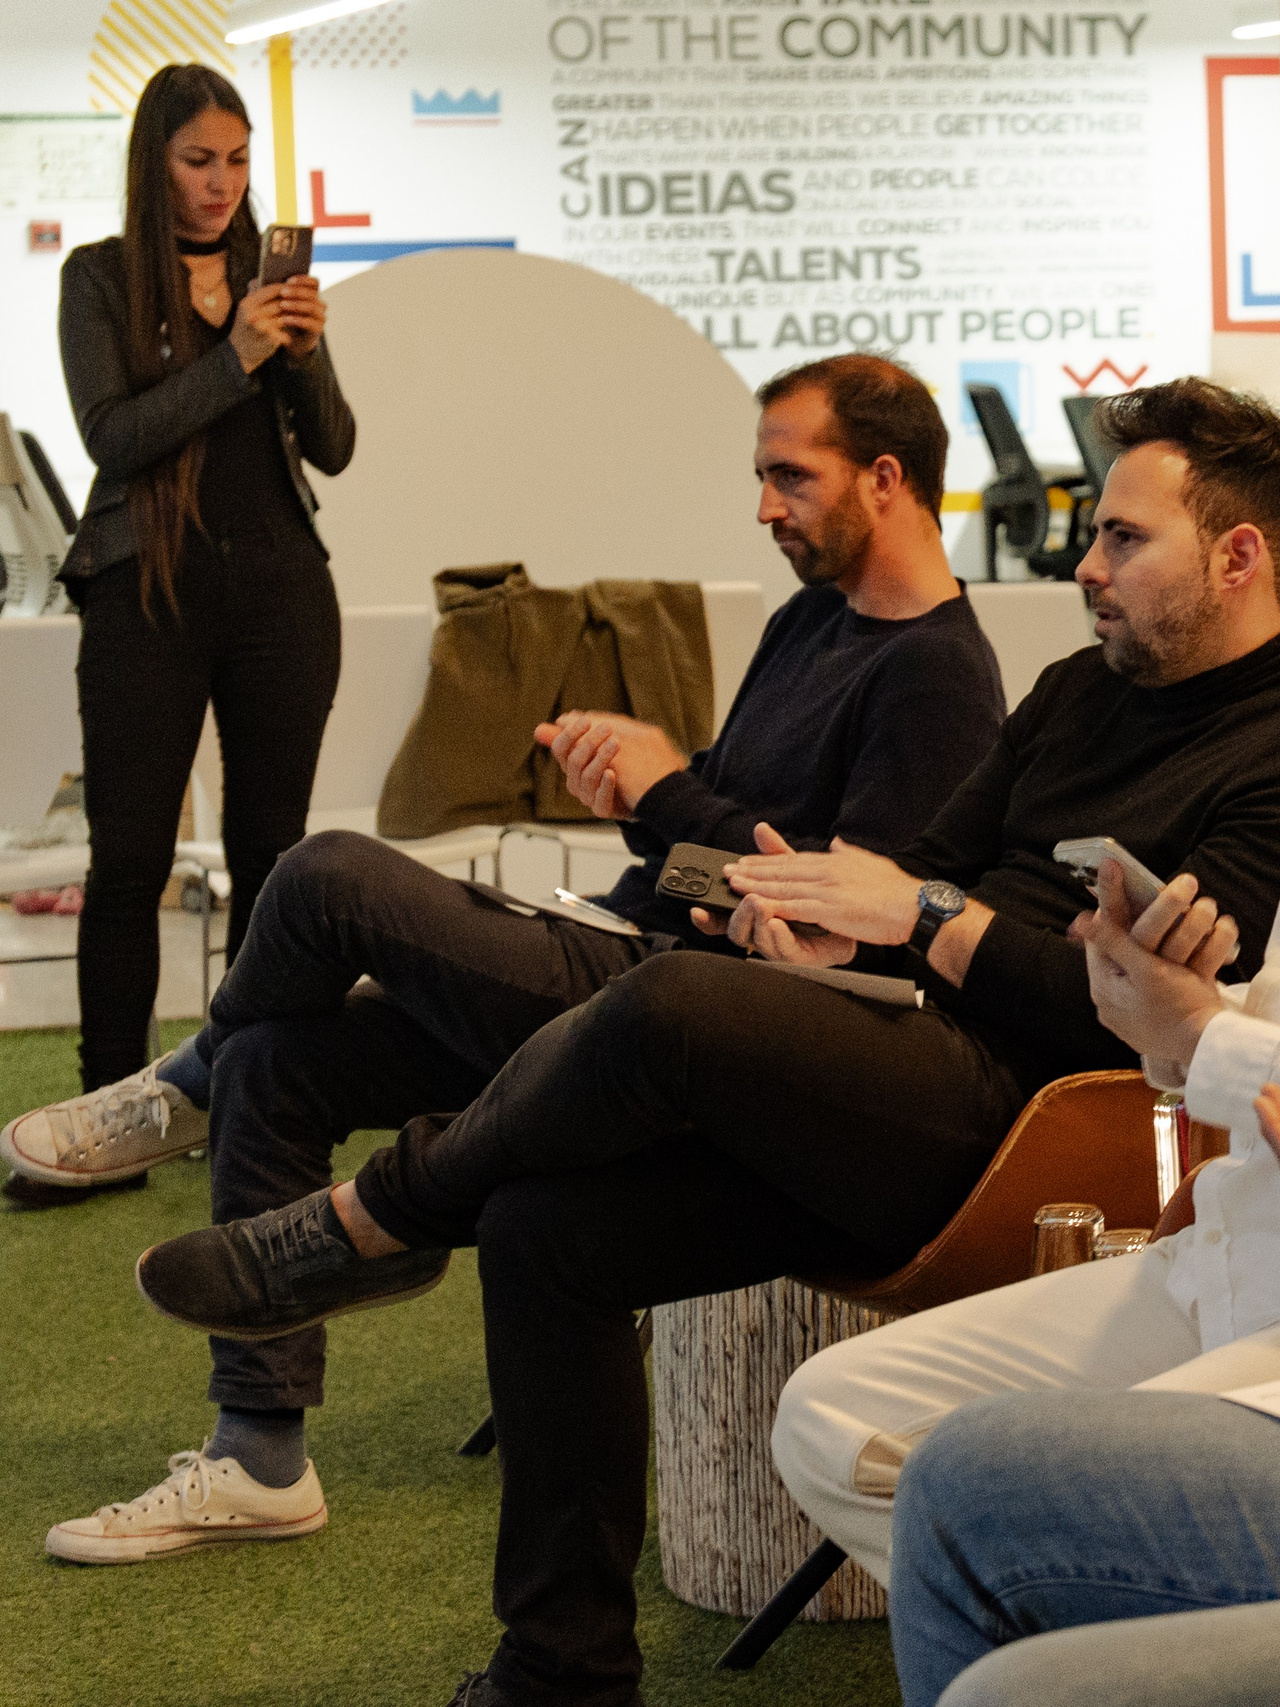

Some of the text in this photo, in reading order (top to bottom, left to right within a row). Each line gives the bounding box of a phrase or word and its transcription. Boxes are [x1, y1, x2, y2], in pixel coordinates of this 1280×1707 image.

[548, 12, 1150, 63] OF THE COMMUNITY
[744, 67, 810, 81] SHARE
[885, 65, 991, 80] AMBITIONS
[551, 93, 653, 110] GREATER
[658, 93, 714, 109] THAN
[859, 91, 891, 107] WE
[896, 90, 975, 107] BELIEVE
[979, 90, 1074, 106] AMAZING
[1079, 89, 1150, 105] THINGS
[590, 112, 1144, 141] HAPPEN WHEN PEOPLE GET TOGETHER
[558, 118, 589, 219] CAN
[598, 169, 798, 217] IDEIAS
[803, 168, 864, 191] AND
[869, 166, 980, 190] PEOPLE
[985, 165, 1044, 188] CAN
[856, 219, 962, 237] CONNECT
[705, 244, 923, 283] TALENTS
[702, 313, 760, 350] LL
[770, 309, 945, 349] ABOUT
